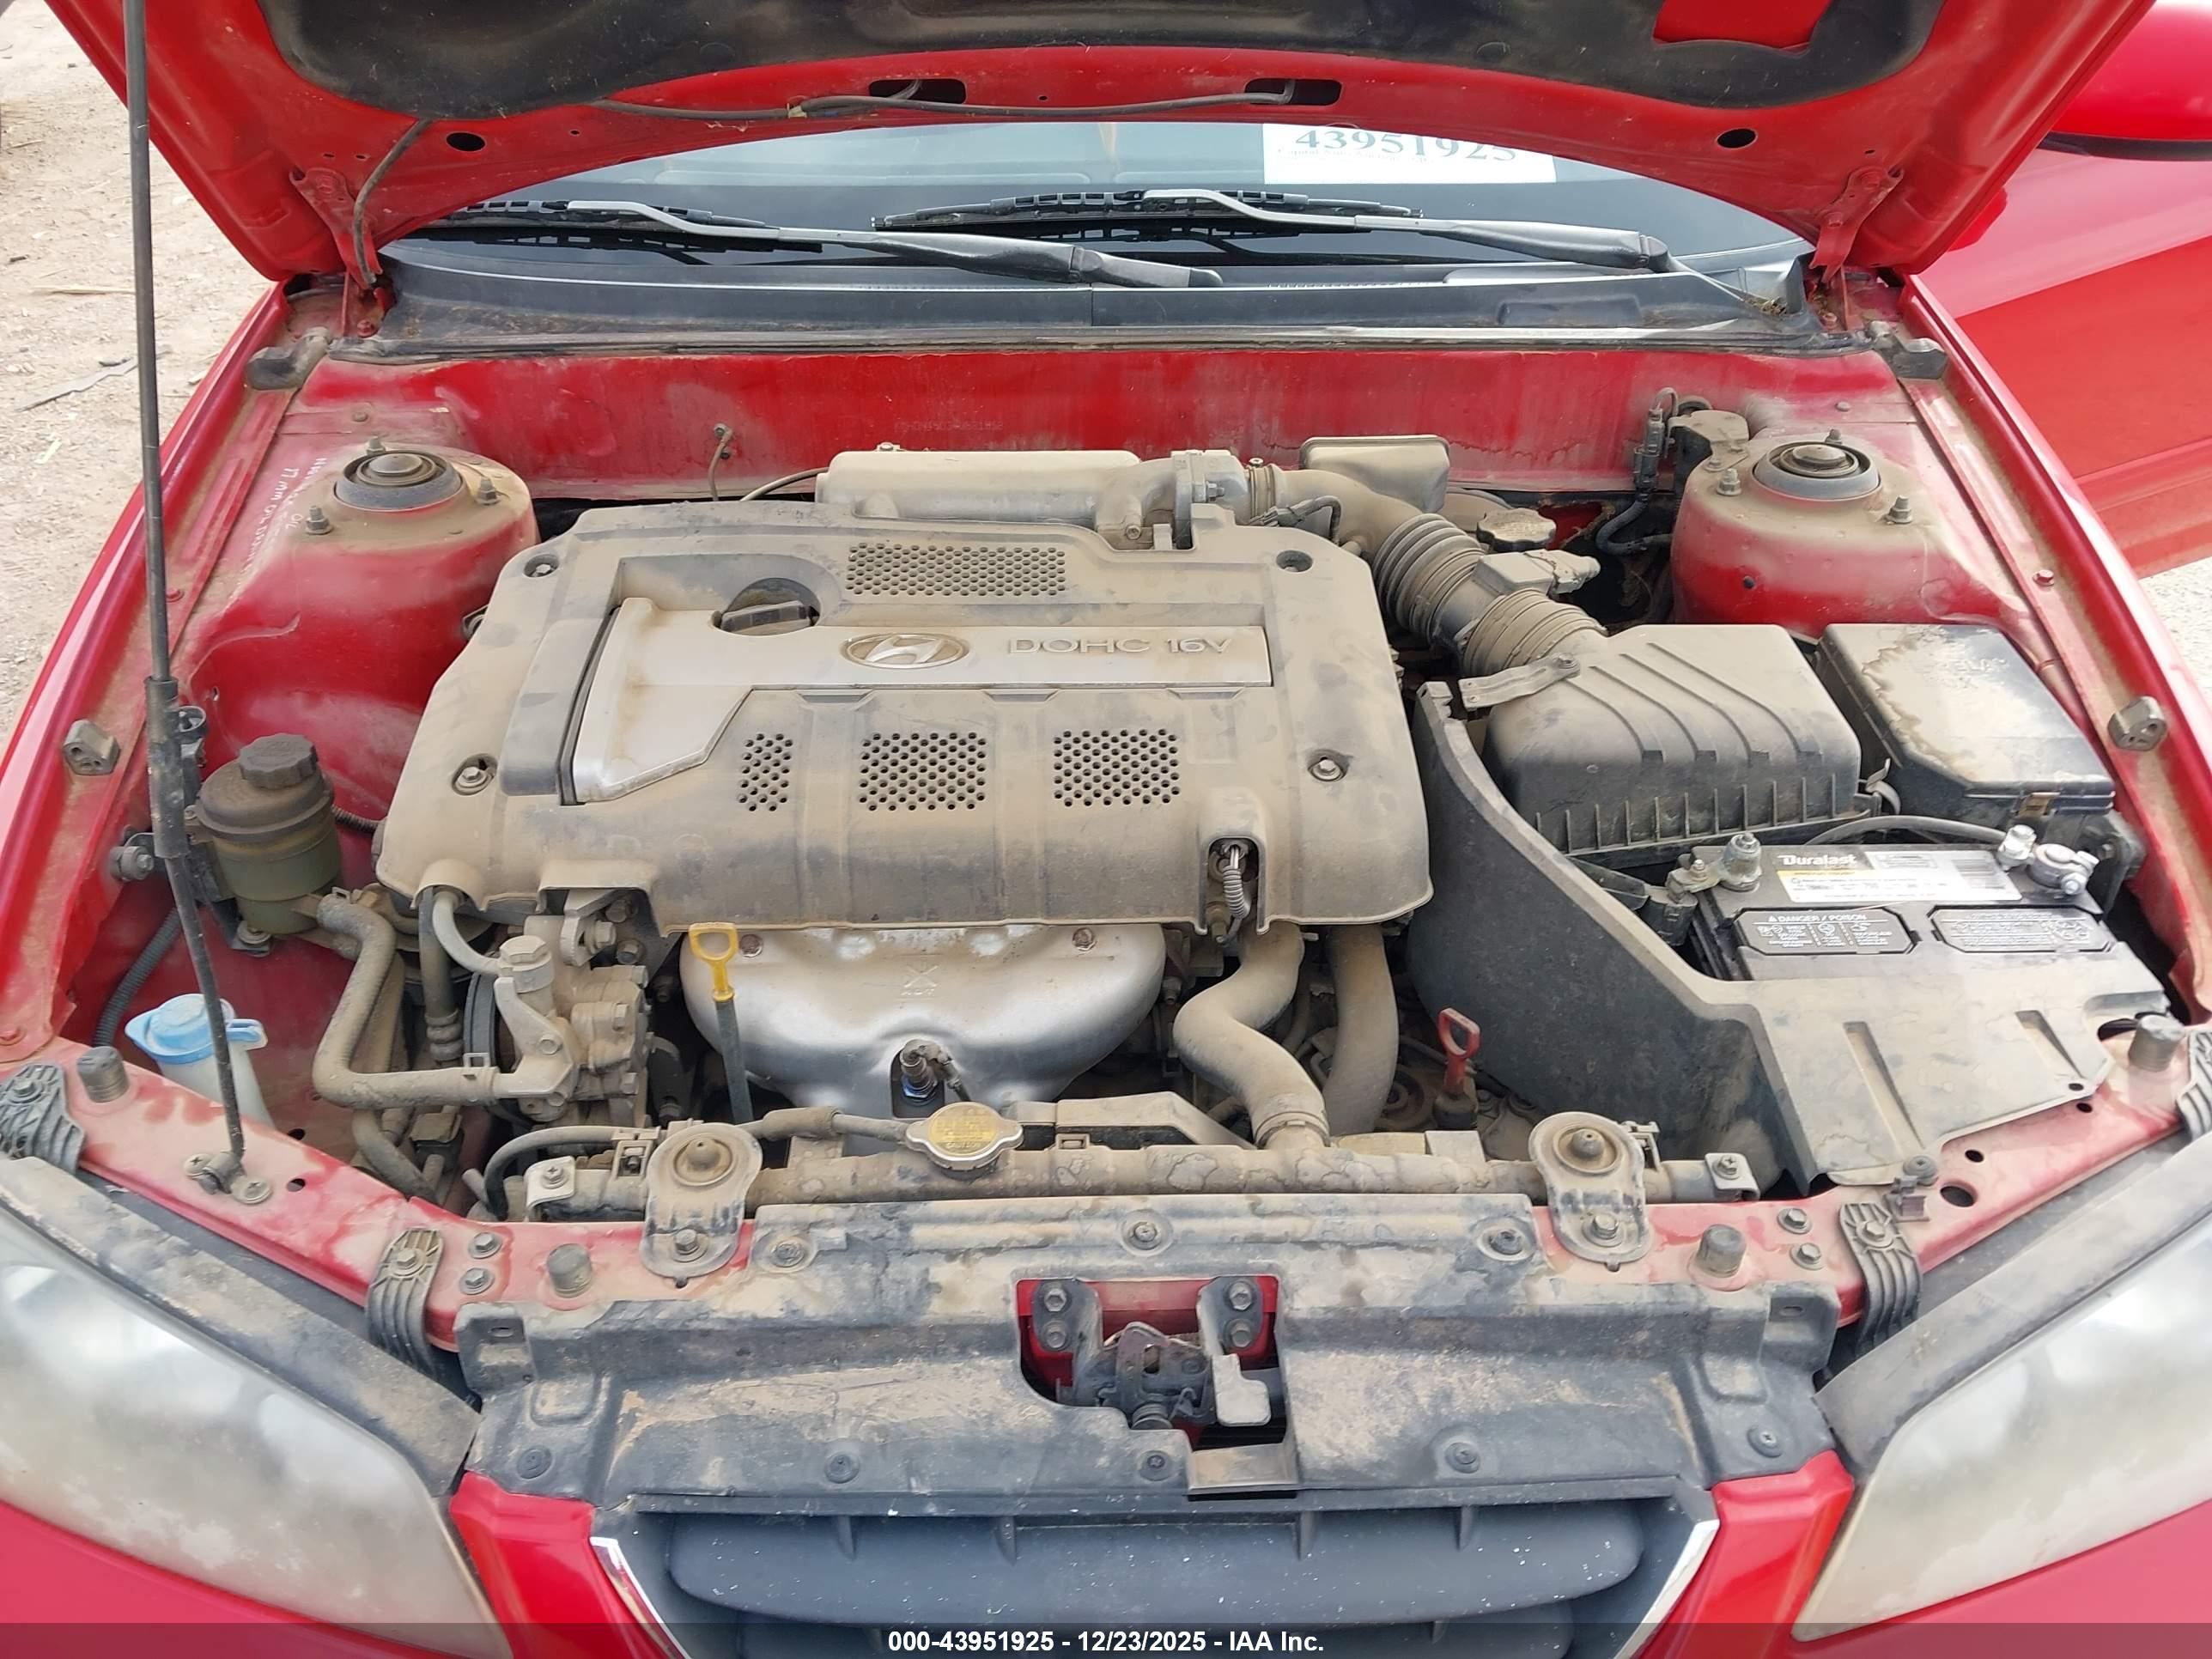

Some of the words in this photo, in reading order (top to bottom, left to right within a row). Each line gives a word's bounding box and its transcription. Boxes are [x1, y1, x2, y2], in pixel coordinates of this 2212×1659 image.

[1009, 638, 1151, 653] DOHC
[1166, 638, 1232, 653] 16V
[1777, 853, 1857, 866] Duralast
[1778, 915, 1819, 923] DANGER
[1829, 914, 1868, 922] POISON
